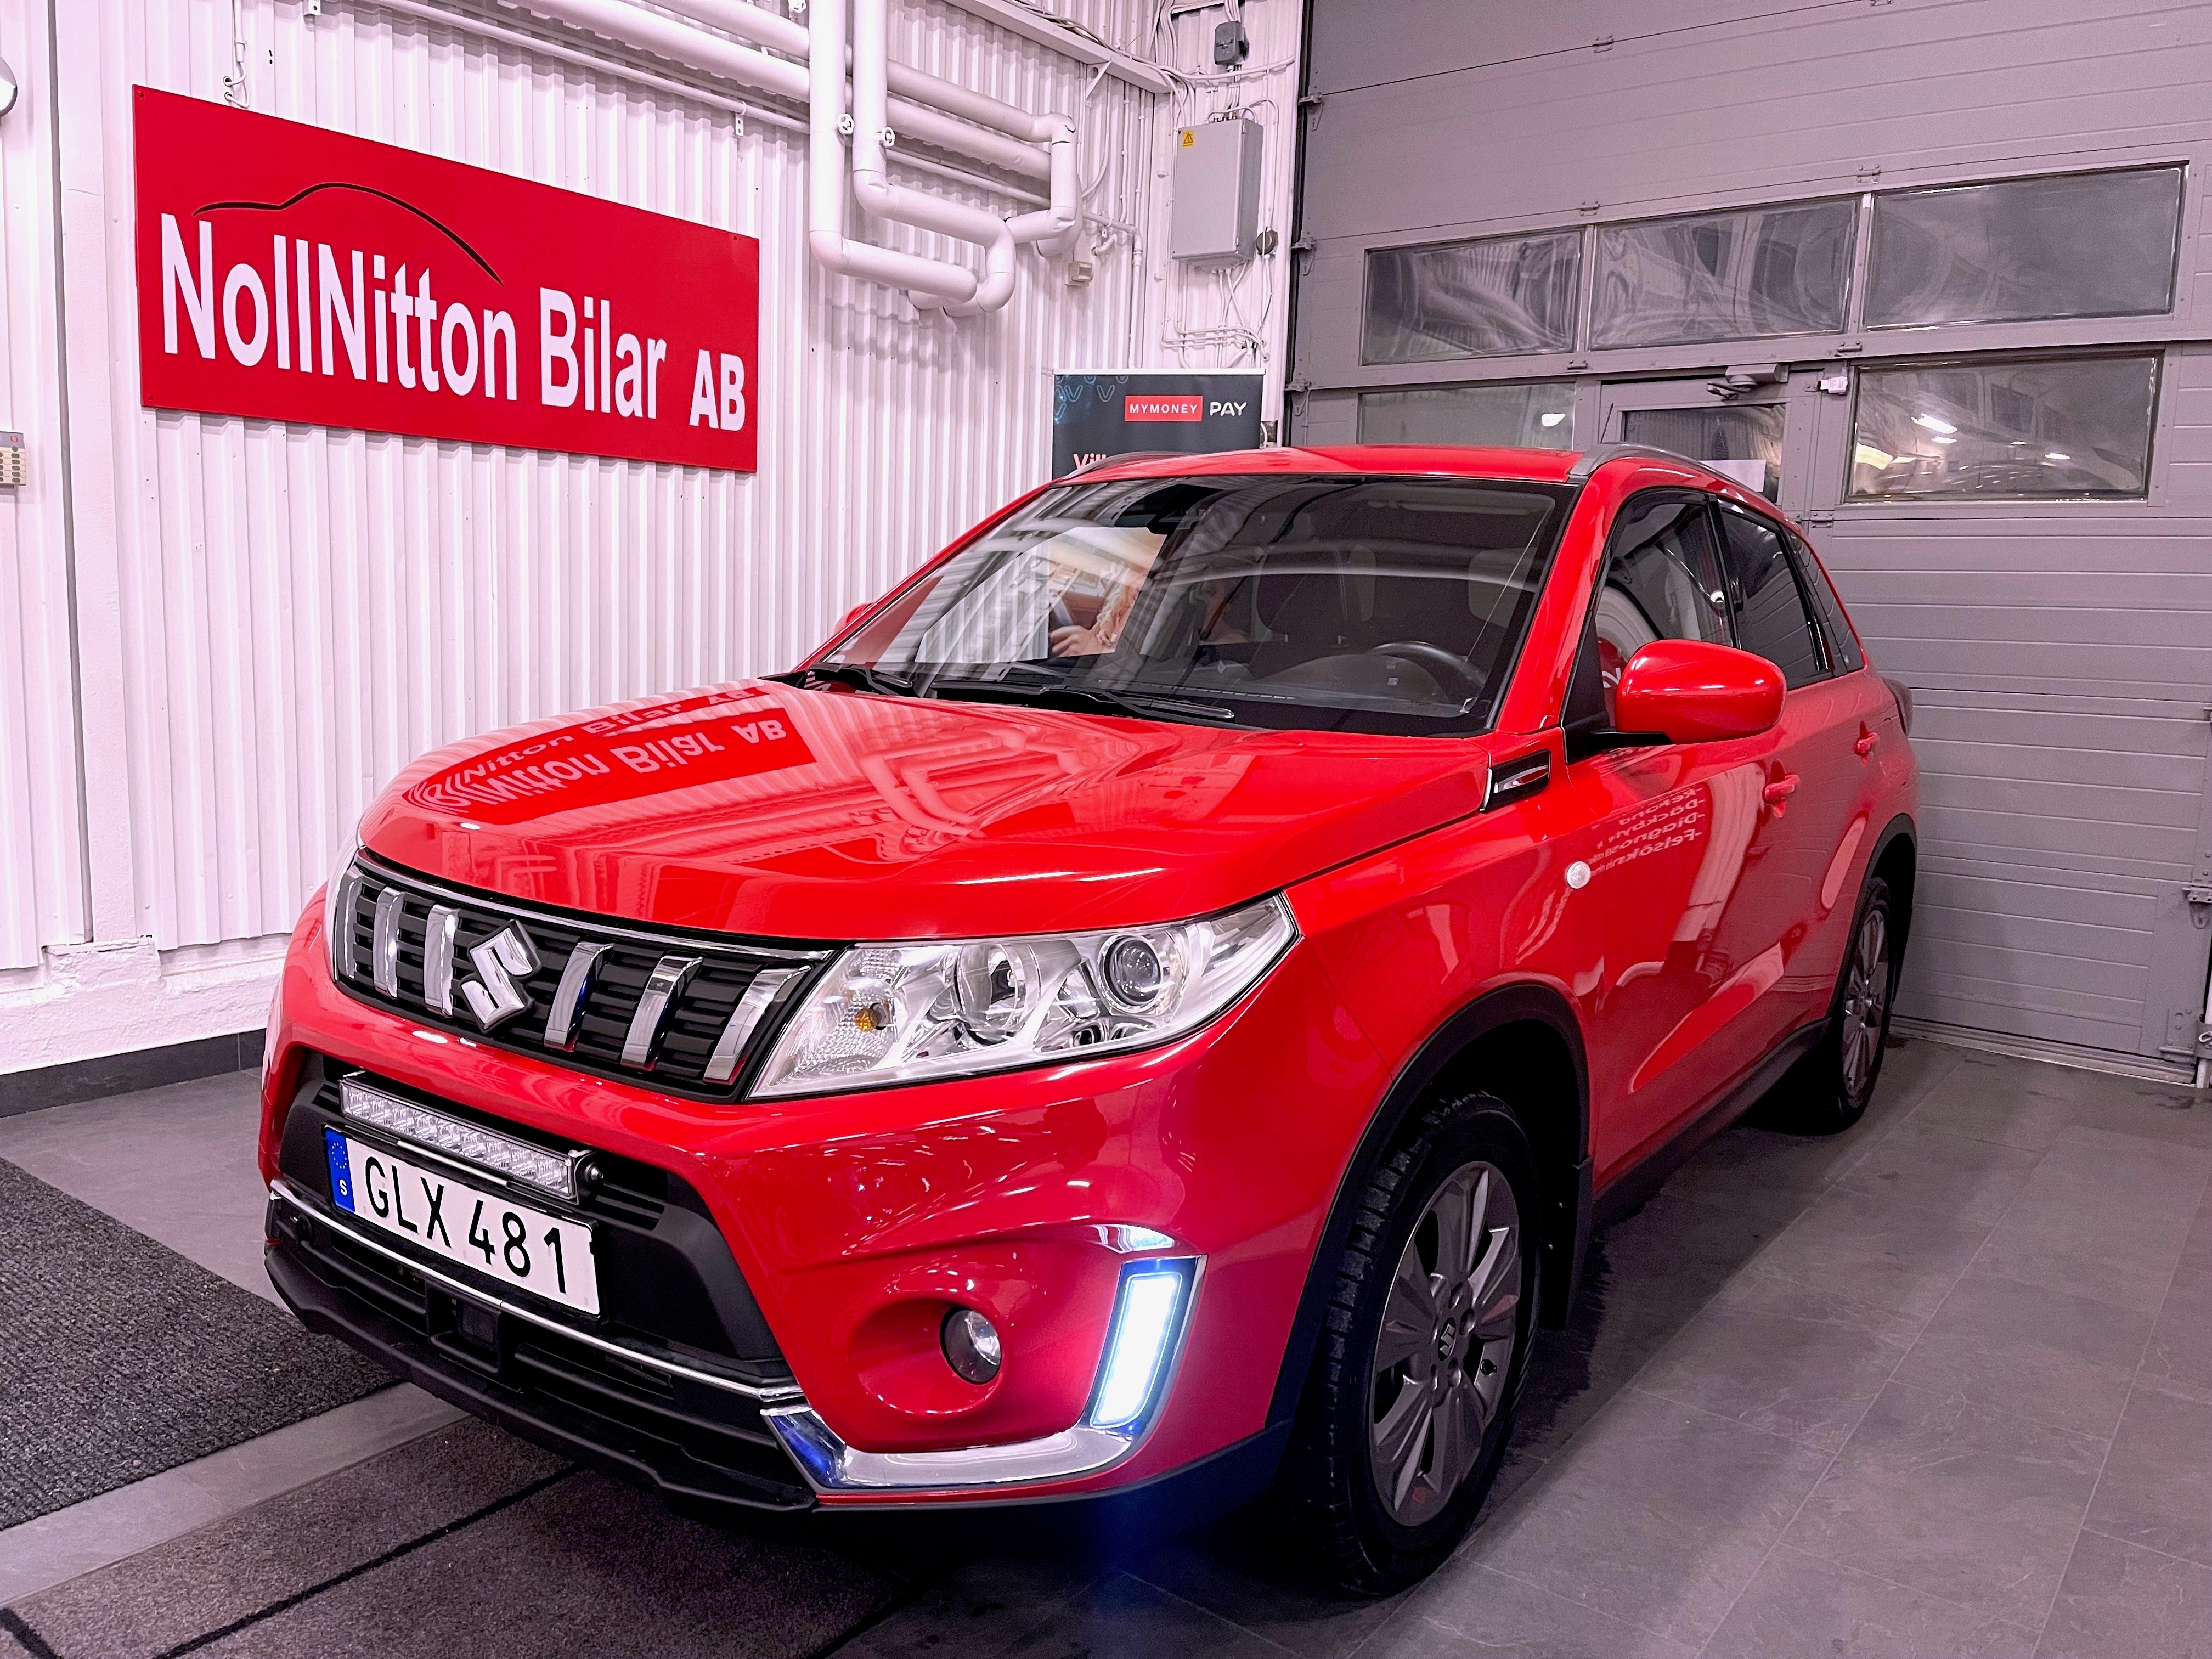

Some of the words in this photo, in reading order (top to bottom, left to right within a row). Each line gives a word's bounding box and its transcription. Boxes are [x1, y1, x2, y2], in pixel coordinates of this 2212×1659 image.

[160, 212, 518, 402] NollNitton
[540, 286, 668, 420] Bilar
[689, 348, 746, 432] AB
[1130, 404, 1198, 414] MYMONEY
[1209, 402, 1247, 416] PAY
[339, 1178, 348, 1197] S
[365, 1156, 452, 1249] GLX
[468, 1198, 567, 1295] 481
